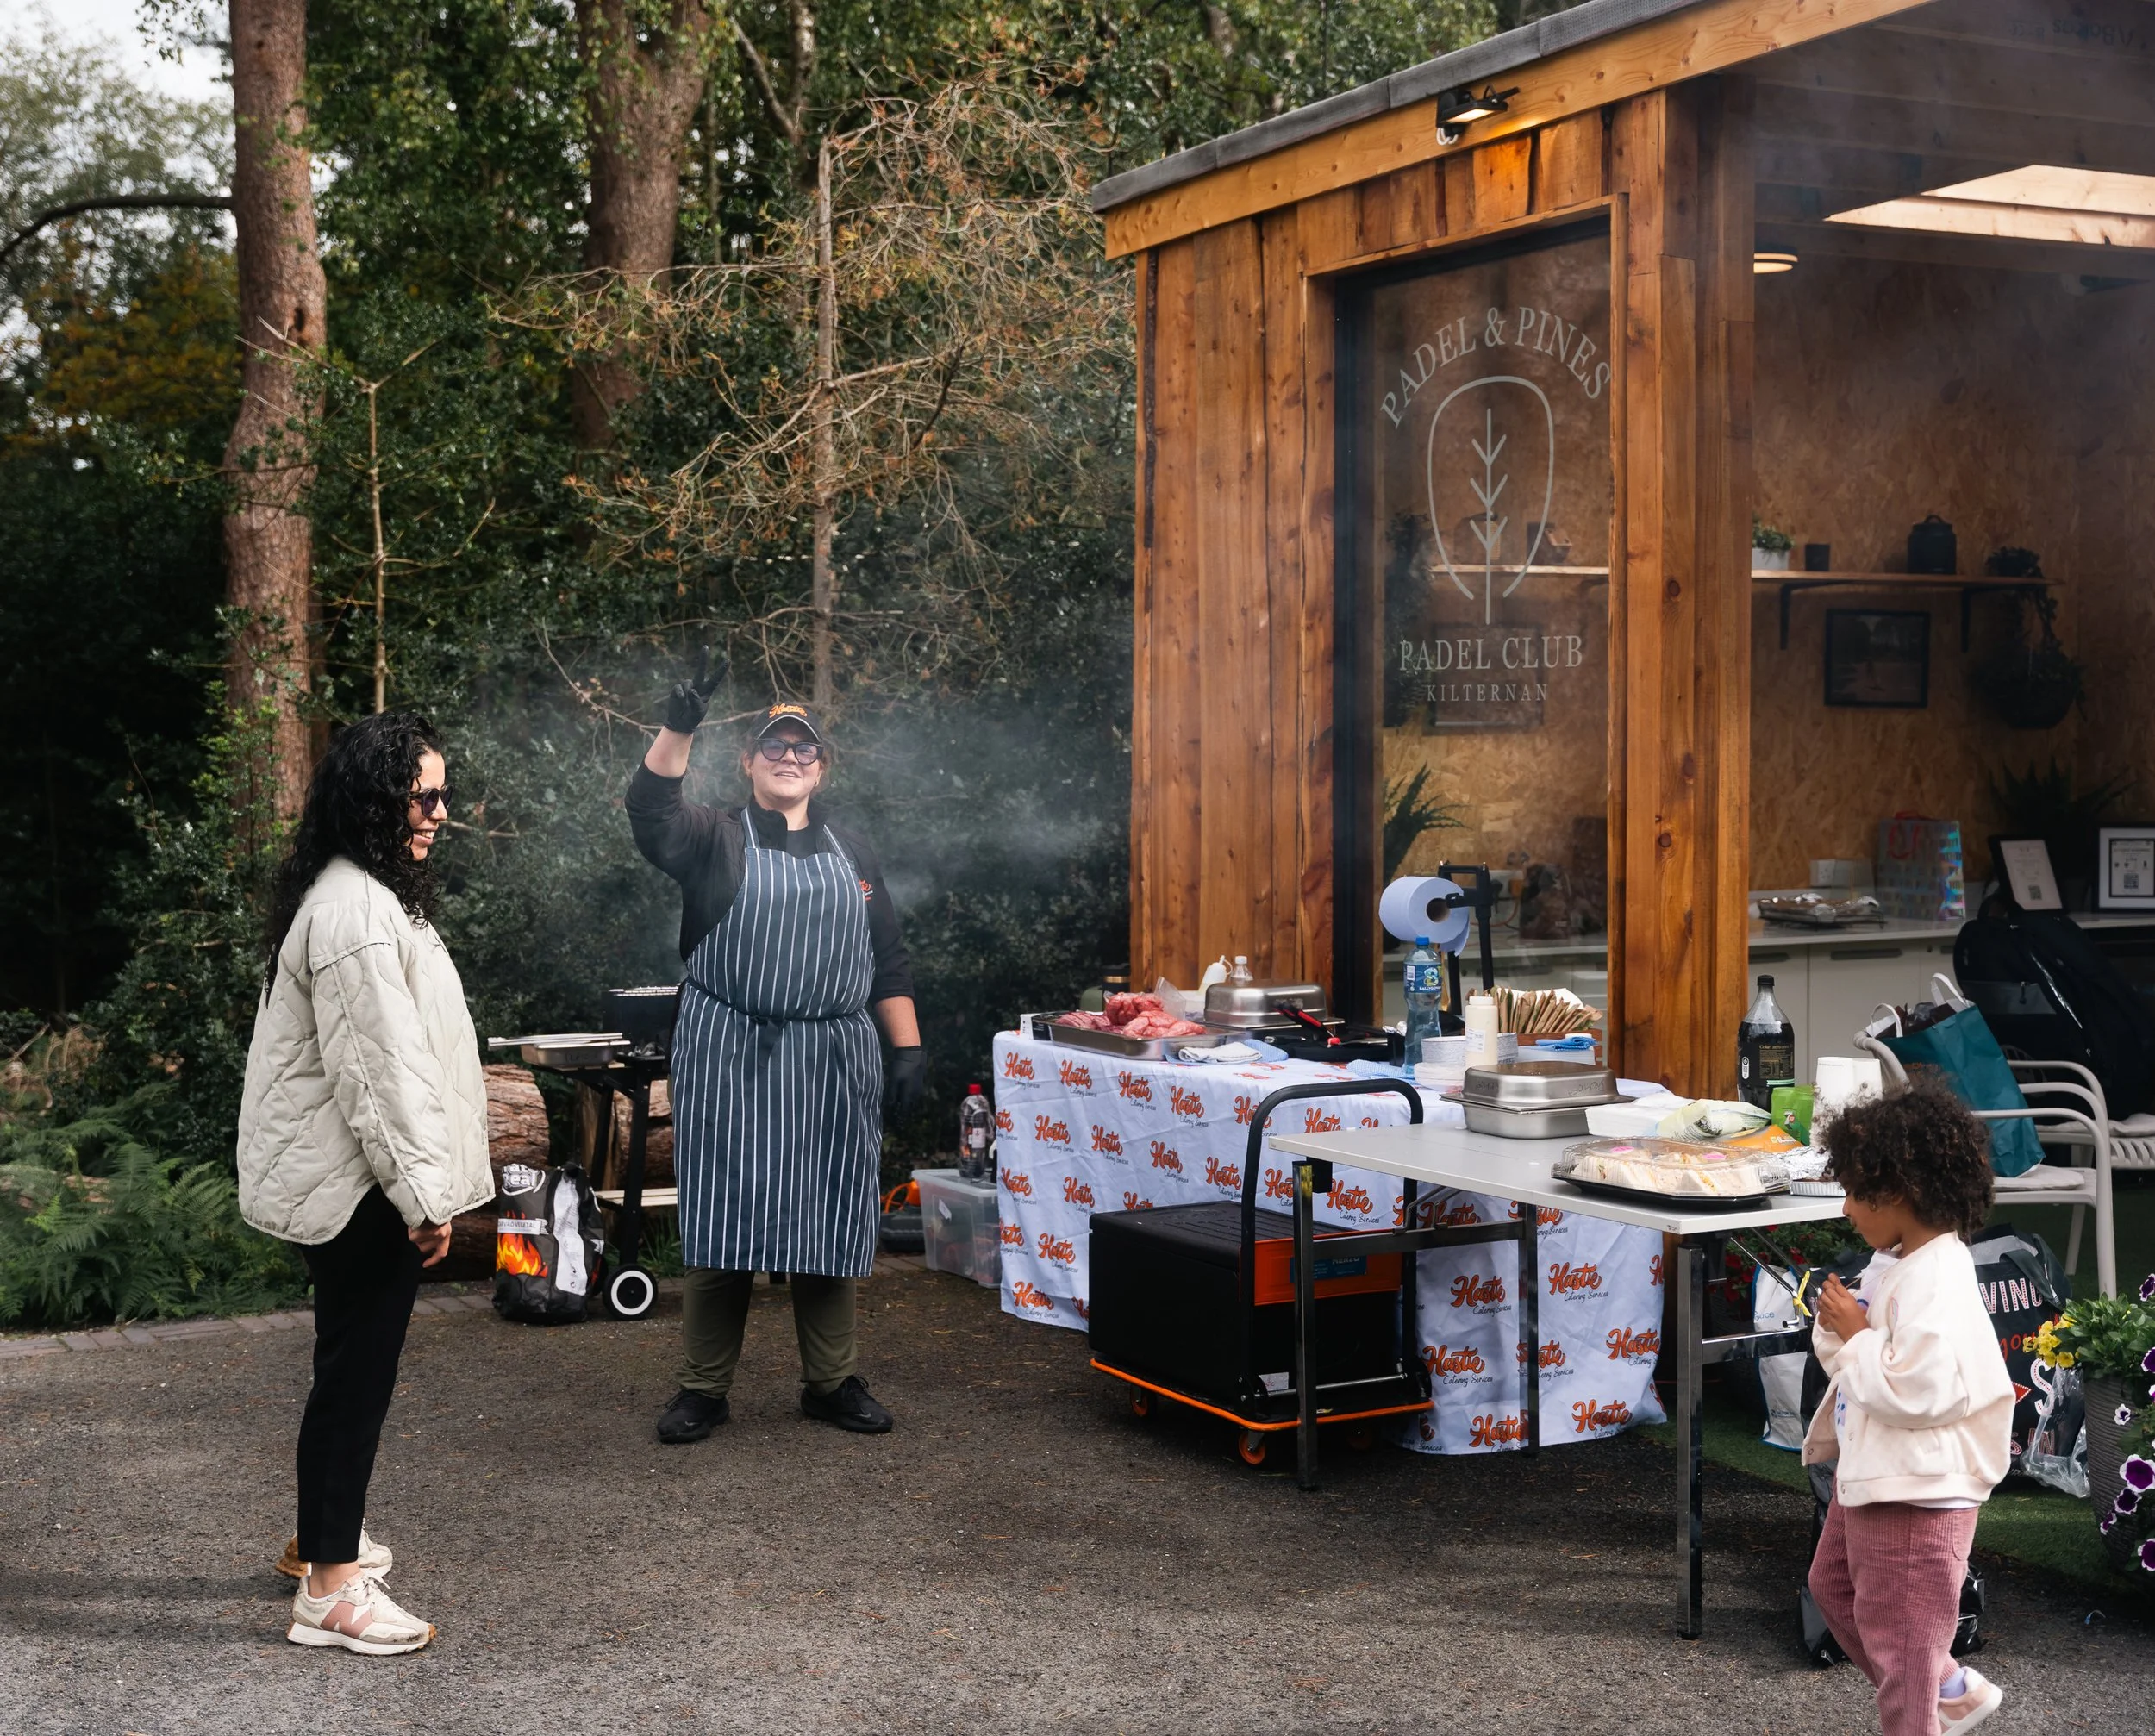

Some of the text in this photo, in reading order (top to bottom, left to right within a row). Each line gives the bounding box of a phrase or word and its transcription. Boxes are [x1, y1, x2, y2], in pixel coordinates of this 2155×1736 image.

[1380, 307, 1611, 429] PADEL & PINES
[1400, 635, 1583, 671] PADEL CLUB
[1427, 684, 1548, 702] KILTERNAN
[1205, 1157, 1242, 1190] Hastie
[1327, 1179, 1373, 1214] Hastie
[1450, 1274, 1506, 1308] Hastie
[1548, 1262, 1602, 1296] Hastie
[1606, 1327, 1661, 1360] Hastie
[1422, 1345, 1485, 1377] Hastie
[1443, 1374, 1493, 1387] Catering Services
[1572, 1399, 1633, 1433] Hastie
